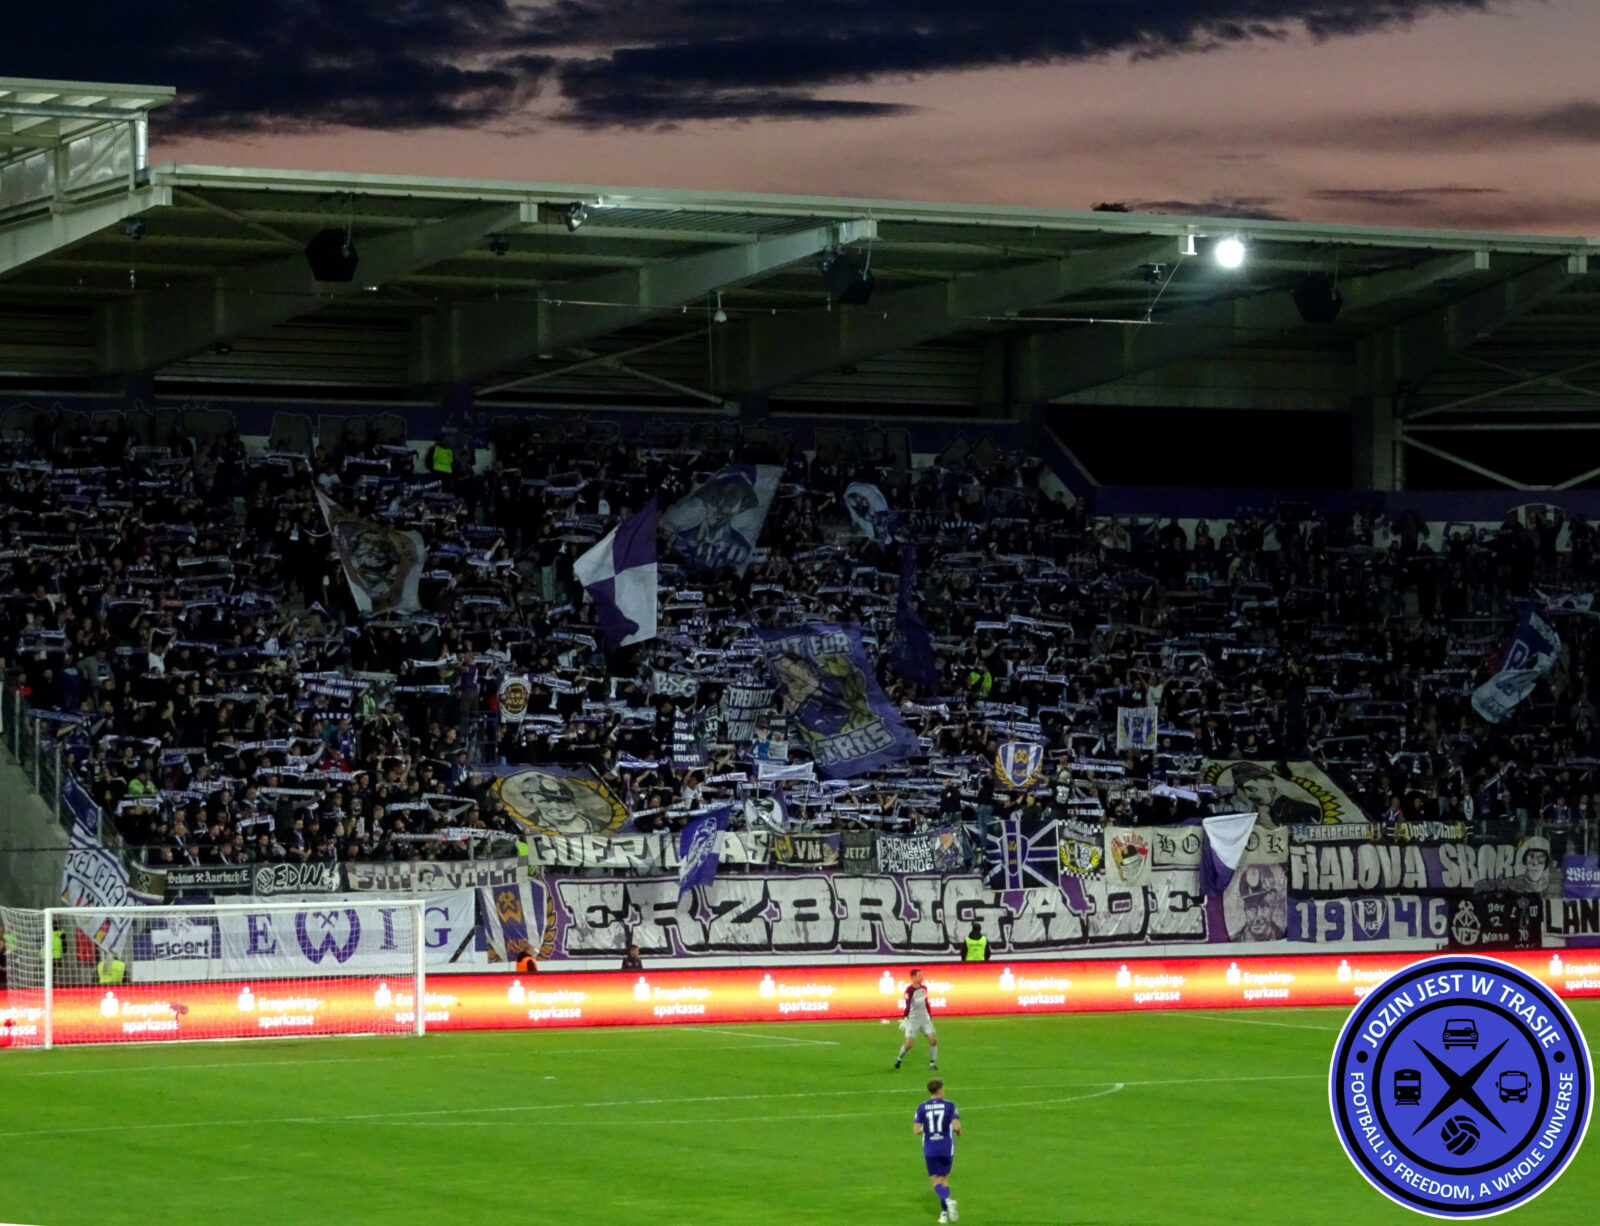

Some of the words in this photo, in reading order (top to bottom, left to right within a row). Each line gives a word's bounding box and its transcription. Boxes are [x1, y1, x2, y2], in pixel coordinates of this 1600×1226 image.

[844, 847, 871, 859] JETZT
[558, 873, 1207, 956] ERZBRIGADE
[1017, 993, 1065, 1006] sparkasse
[1133, 990, 1180, 1003] sparkasse
[1243, 987, 1289, 1000] sparkasse
[653, 1003, 705, 1016] sparkasse
[778, 1000, 829, 1013] sparkasse
[395, 1011, 450, 1024] spaasse
[528, 1007, 582, 1020] sparkasse
[258, 1013, 314, 1028] sparkasse
[926, 1109, 945, 1133] 17
